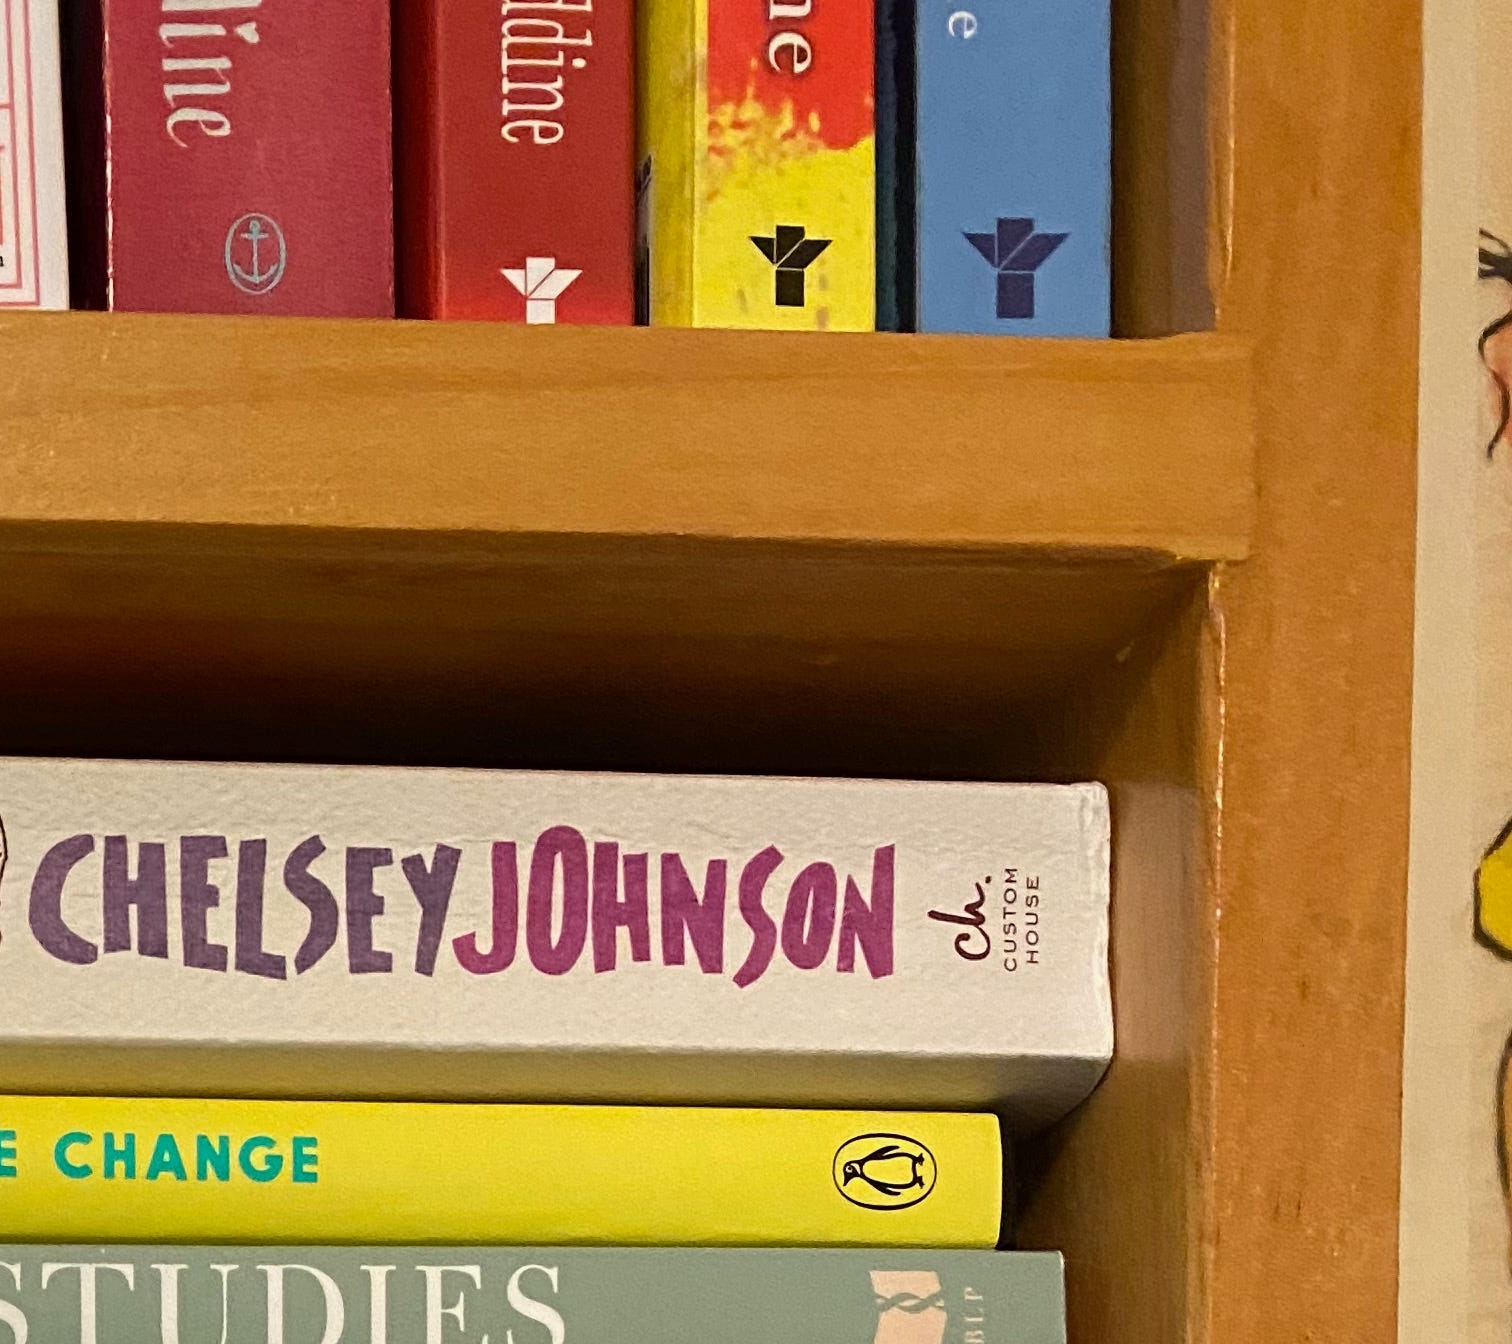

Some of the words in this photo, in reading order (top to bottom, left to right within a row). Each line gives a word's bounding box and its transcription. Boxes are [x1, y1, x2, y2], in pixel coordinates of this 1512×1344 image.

[29, 833, 462, 980] CHELSEY
[452, 825, 896, 988] JOHNSON
[1004, 867, 1018, 972] CUSTOM
[1026, 874, 1040, 965] HOUSE
[54, 1131, 319, 1183] CHANGE
[963, 1285, 985, 1344] BLP
